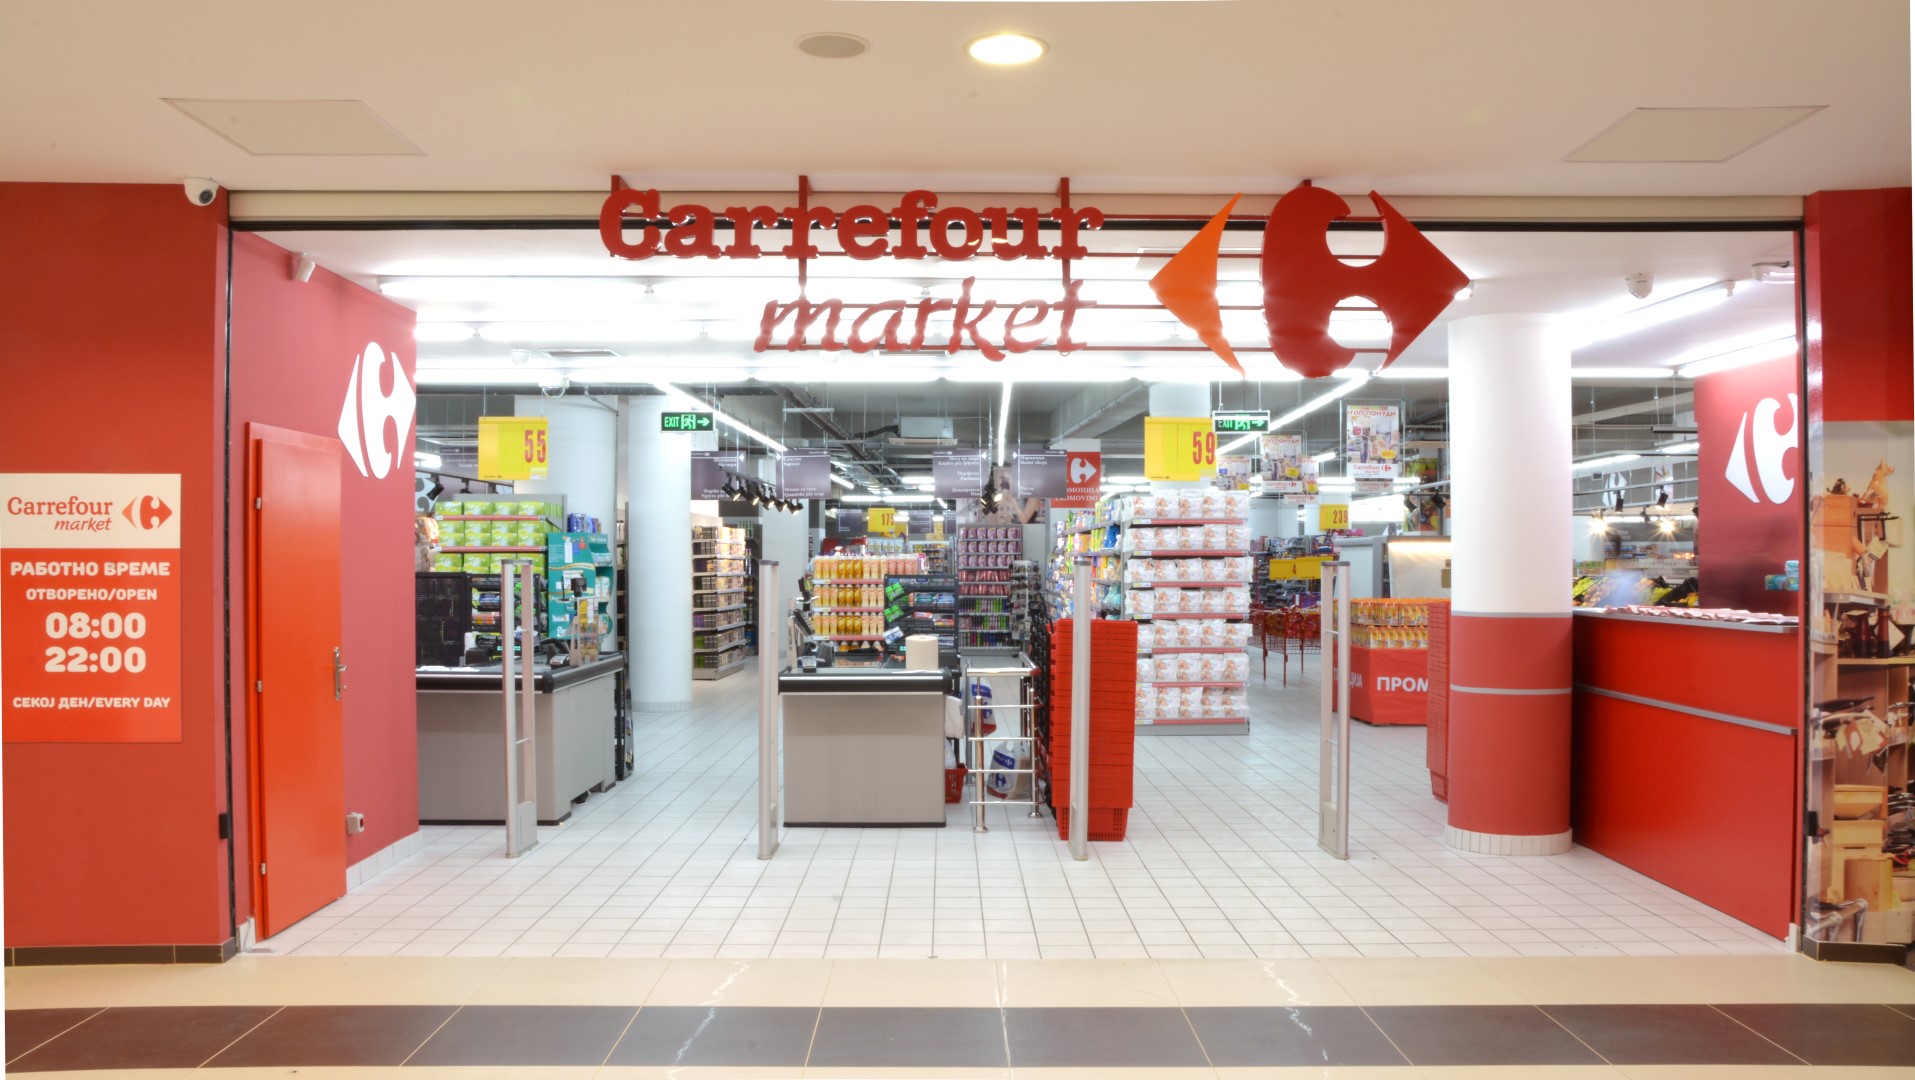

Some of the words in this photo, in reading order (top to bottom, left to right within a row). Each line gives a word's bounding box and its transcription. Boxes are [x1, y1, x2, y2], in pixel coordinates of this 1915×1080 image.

[600, 189, 1104, 261] Carrefour
[754, 276, 1097, 362] market
[664, 416, 680, 428] EXIT
[524, 429, 547, 463] 55
[1192, 431, 1216, 465] 59
[7, 496, 113, 516] Carrefour
[54, 517, 112, 533] market
[10, 562, 98, 576] РАБОТНО
[104, 562, 171, 576] ВРЕМЕ
[26, 588, 158, 601] ОТВОРЕНО/OPEN
[45, 612, 147, 640] 08:00
[44, 646, 147, 673] 22:00
[12, 697, 55, 708] СЕКОЈ
[58, 697, 140, 710] ДЕН/EVERY
[144, 697, 171, 708] DAY
